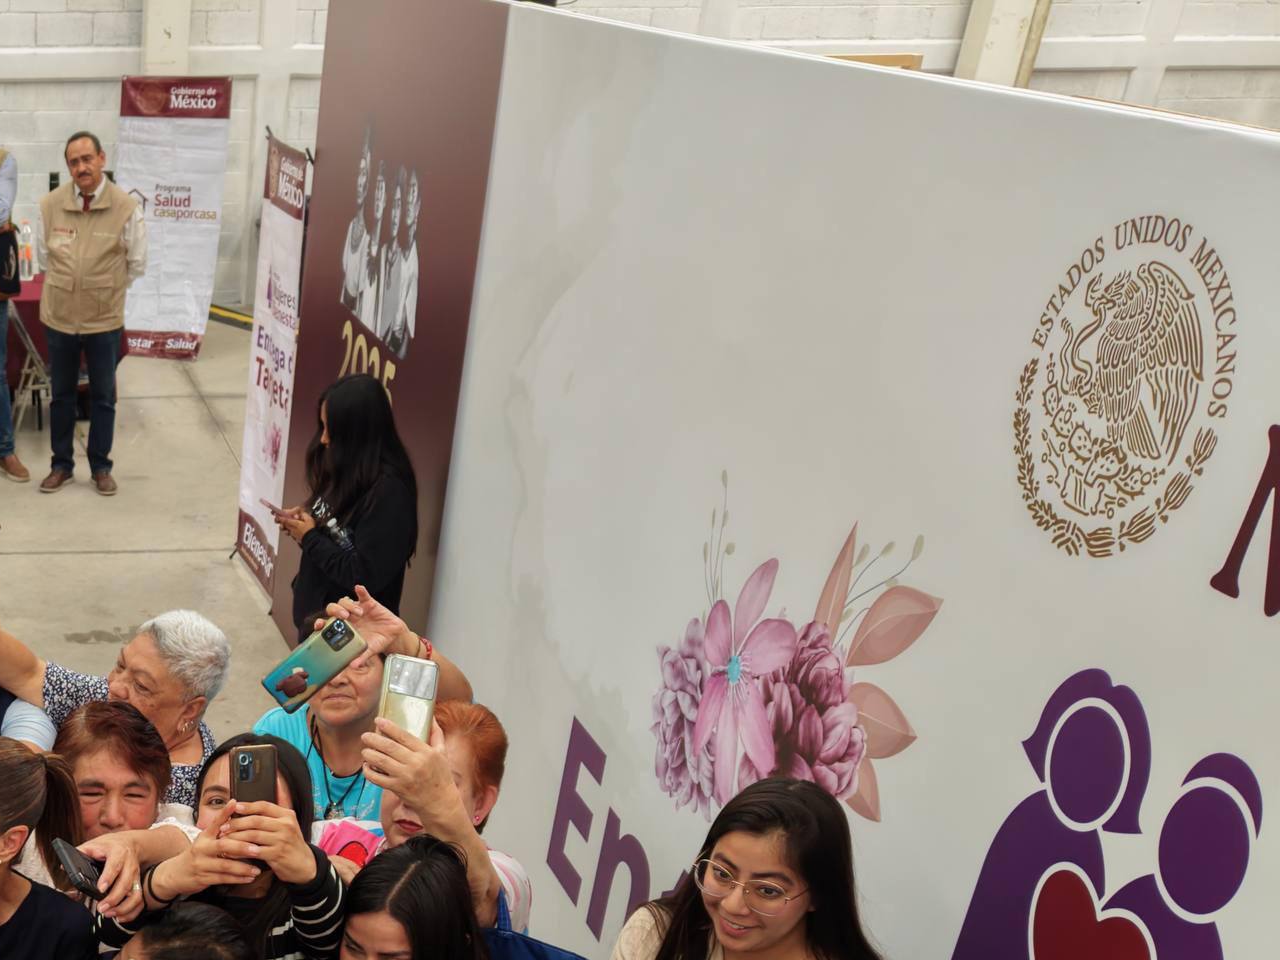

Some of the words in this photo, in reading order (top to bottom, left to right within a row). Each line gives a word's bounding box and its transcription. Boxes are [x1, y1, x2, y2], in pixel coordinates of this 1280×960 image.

[170, 87, 205, 96] Gobierno
[206, 87, 217, 95] de
[169, 95, 217, 109] México
[155, 184, 191, 193] Programa
[278, 172, 303, 208] México
[154, 193, 191, 208] Salud
[153, 206, 217, 220] casaporcasa
[1031, 236, 1105, 351] ESTADOS
[1114, 214, 1194, 253] UNIDOS
[1189, 236, 1238, 420] MEXICANOS
[165, 337, 197, 350] Salud
